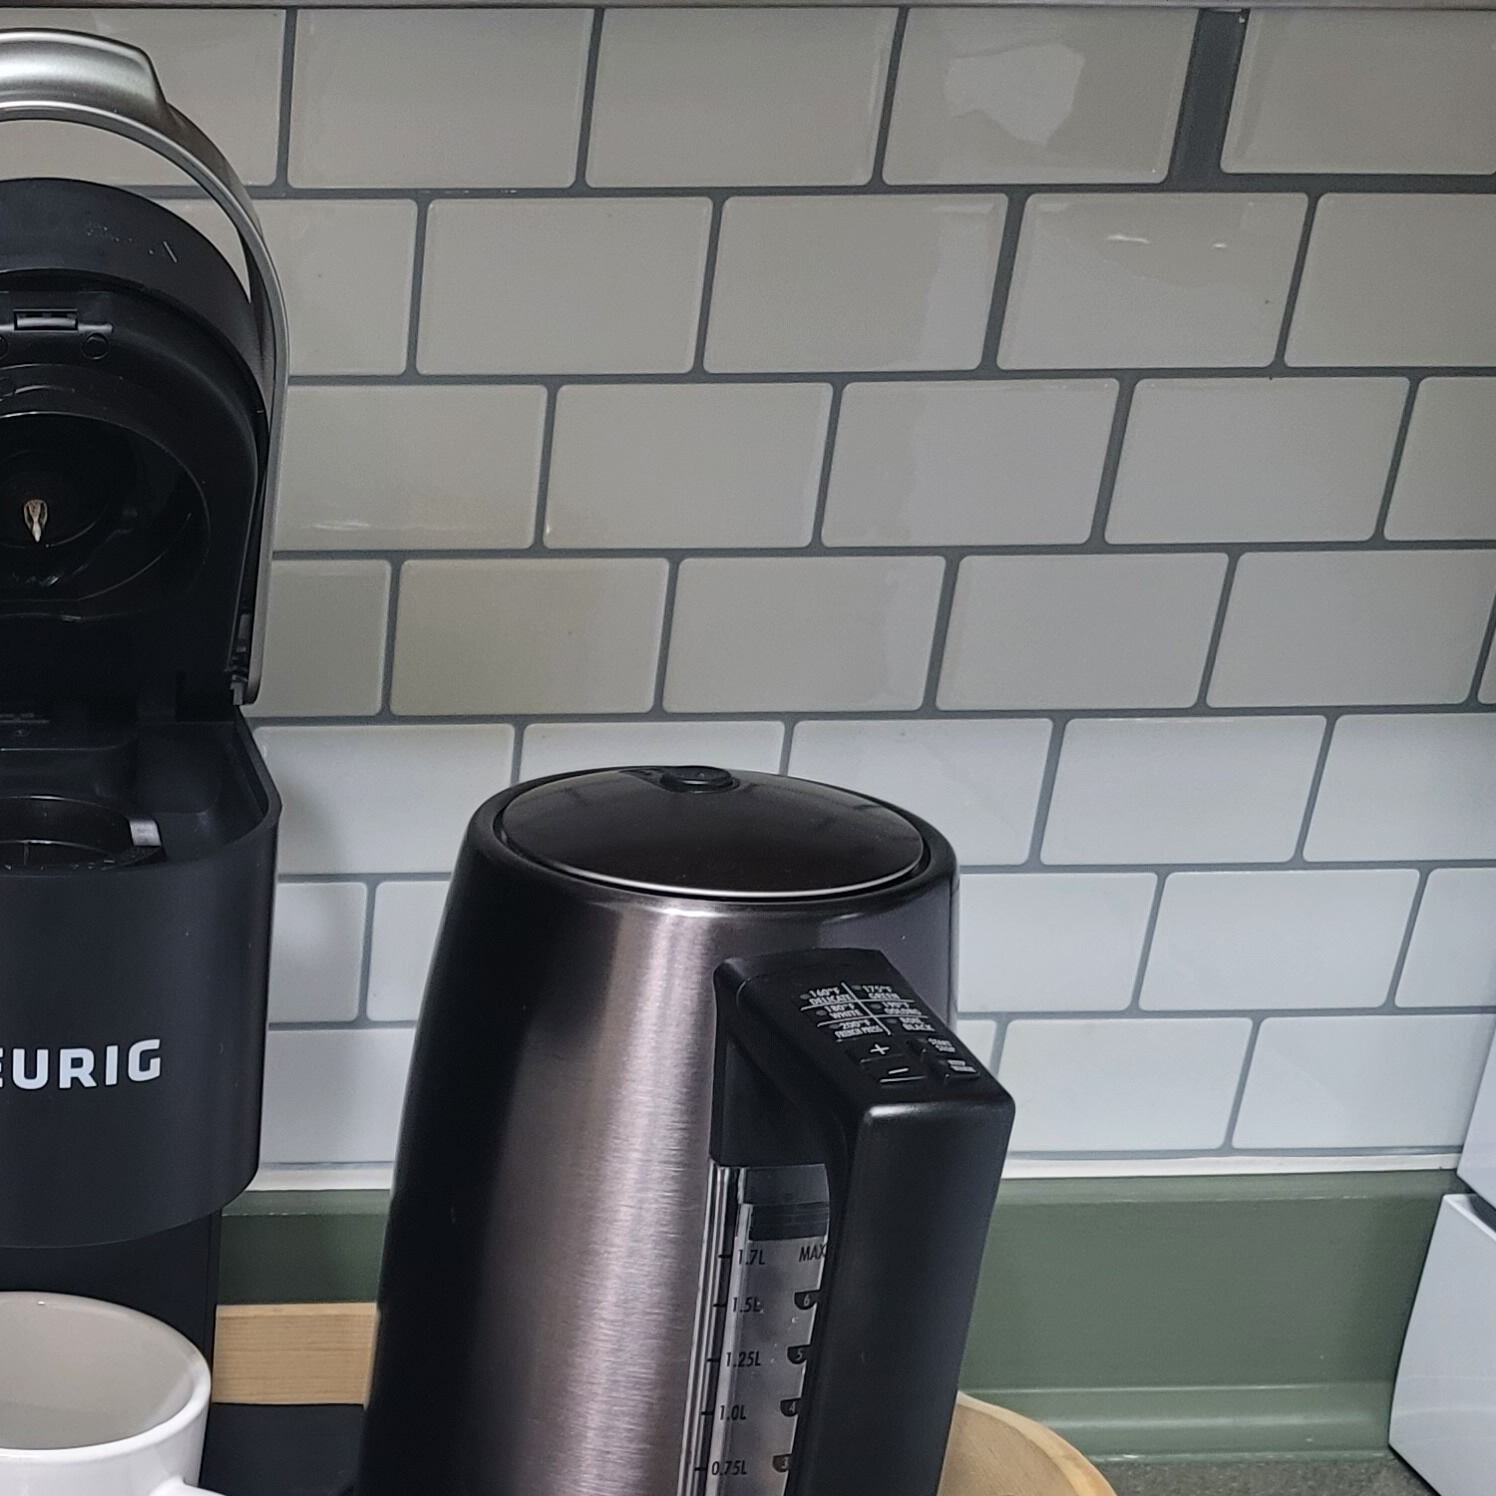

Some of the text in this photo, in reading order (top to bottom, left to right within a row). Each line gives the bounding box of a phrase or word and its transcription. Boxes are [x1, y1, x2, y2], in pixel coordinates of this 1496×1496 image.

[737, 1248, 765, 1266] 1.7L
[798, 1243, 826, 1263] MAX
[732, 1297, 762, 1313] 1.5L
[725, 1350, 761, 1368] 1.25L
[719, 1405, 747, 1421] 1.0L
[711, 1460, 747, 1476] 0.75L
